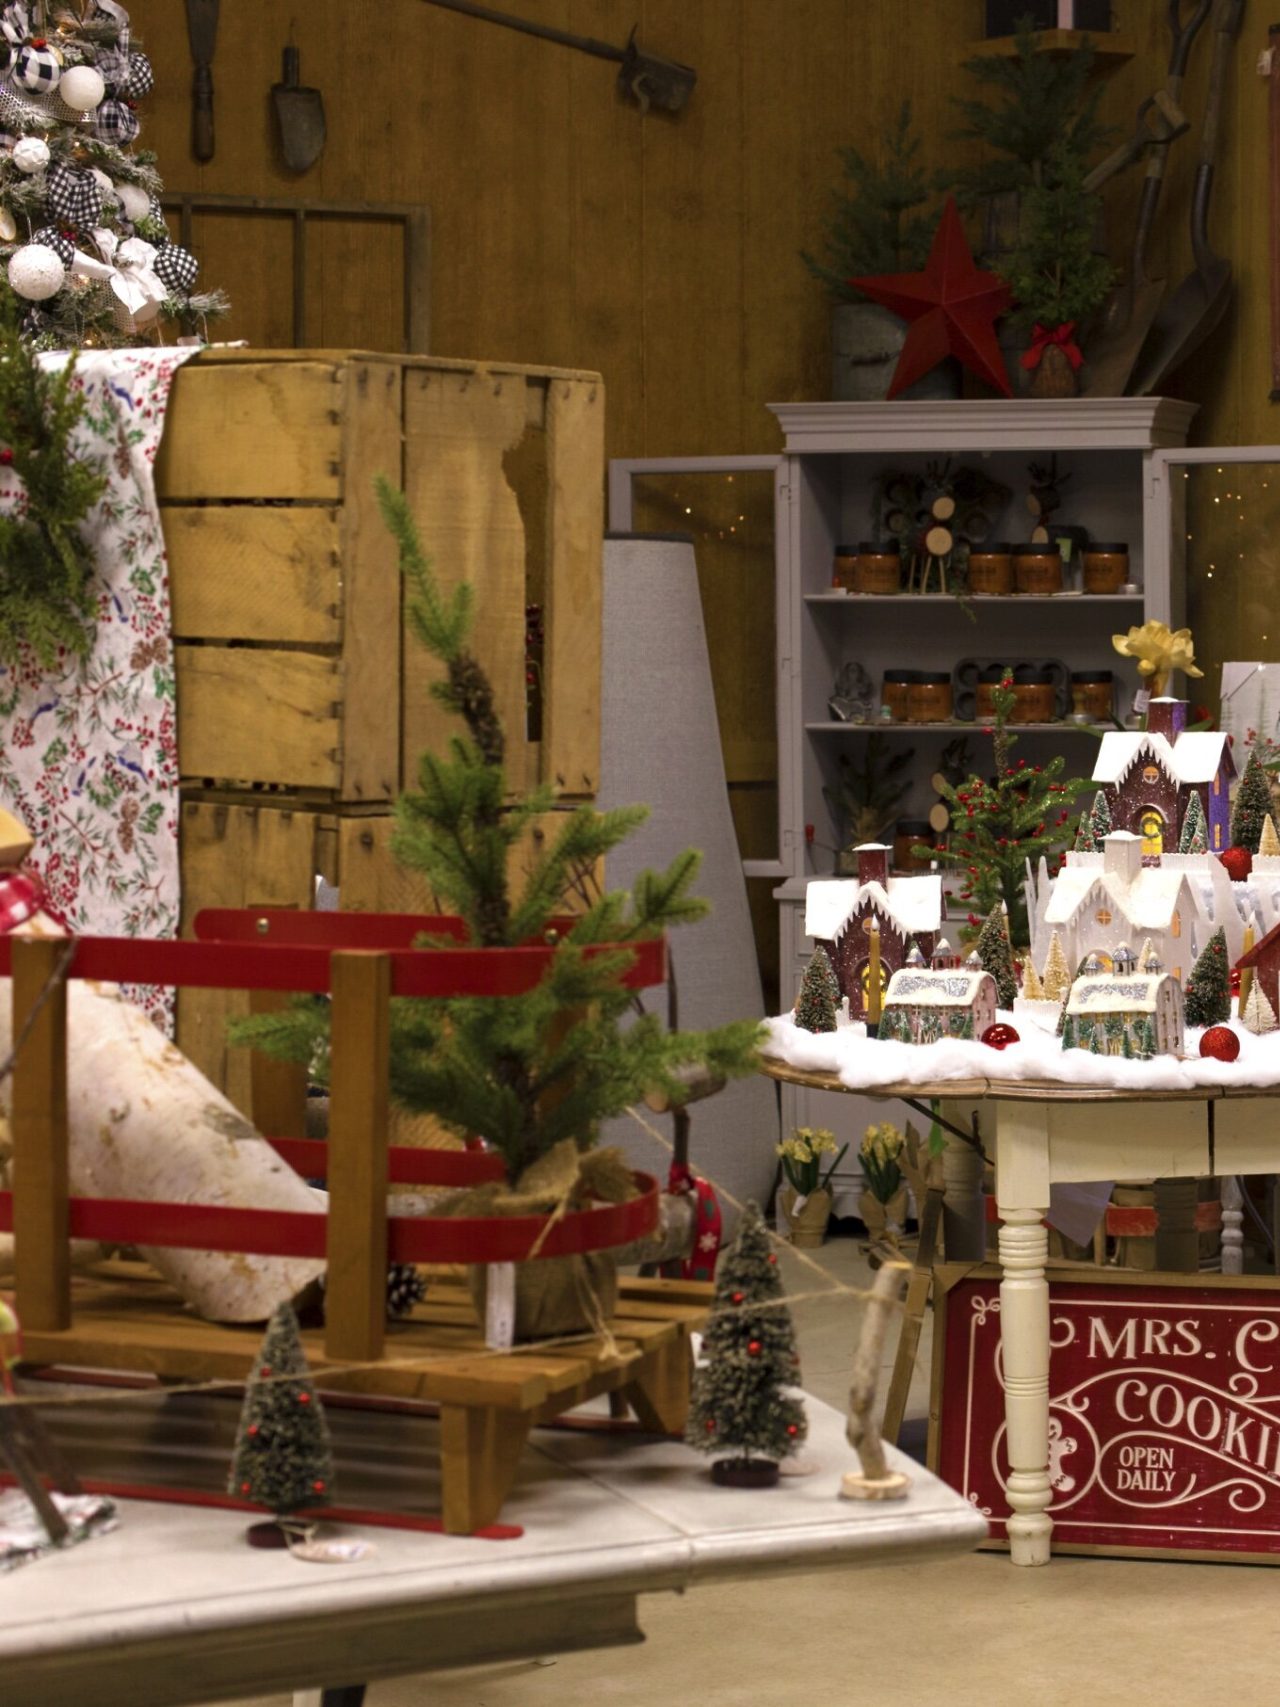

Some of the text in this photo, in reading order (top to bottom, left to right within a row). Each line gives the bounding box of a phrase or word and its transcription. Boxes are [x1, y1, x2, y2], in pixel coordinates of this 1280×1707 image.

[1087, 1316, 1217, 1360] MRS.
[1119, 1446, 1175, 1470] OPEN
[1117, 1469, 1176, 1492] DAILY
